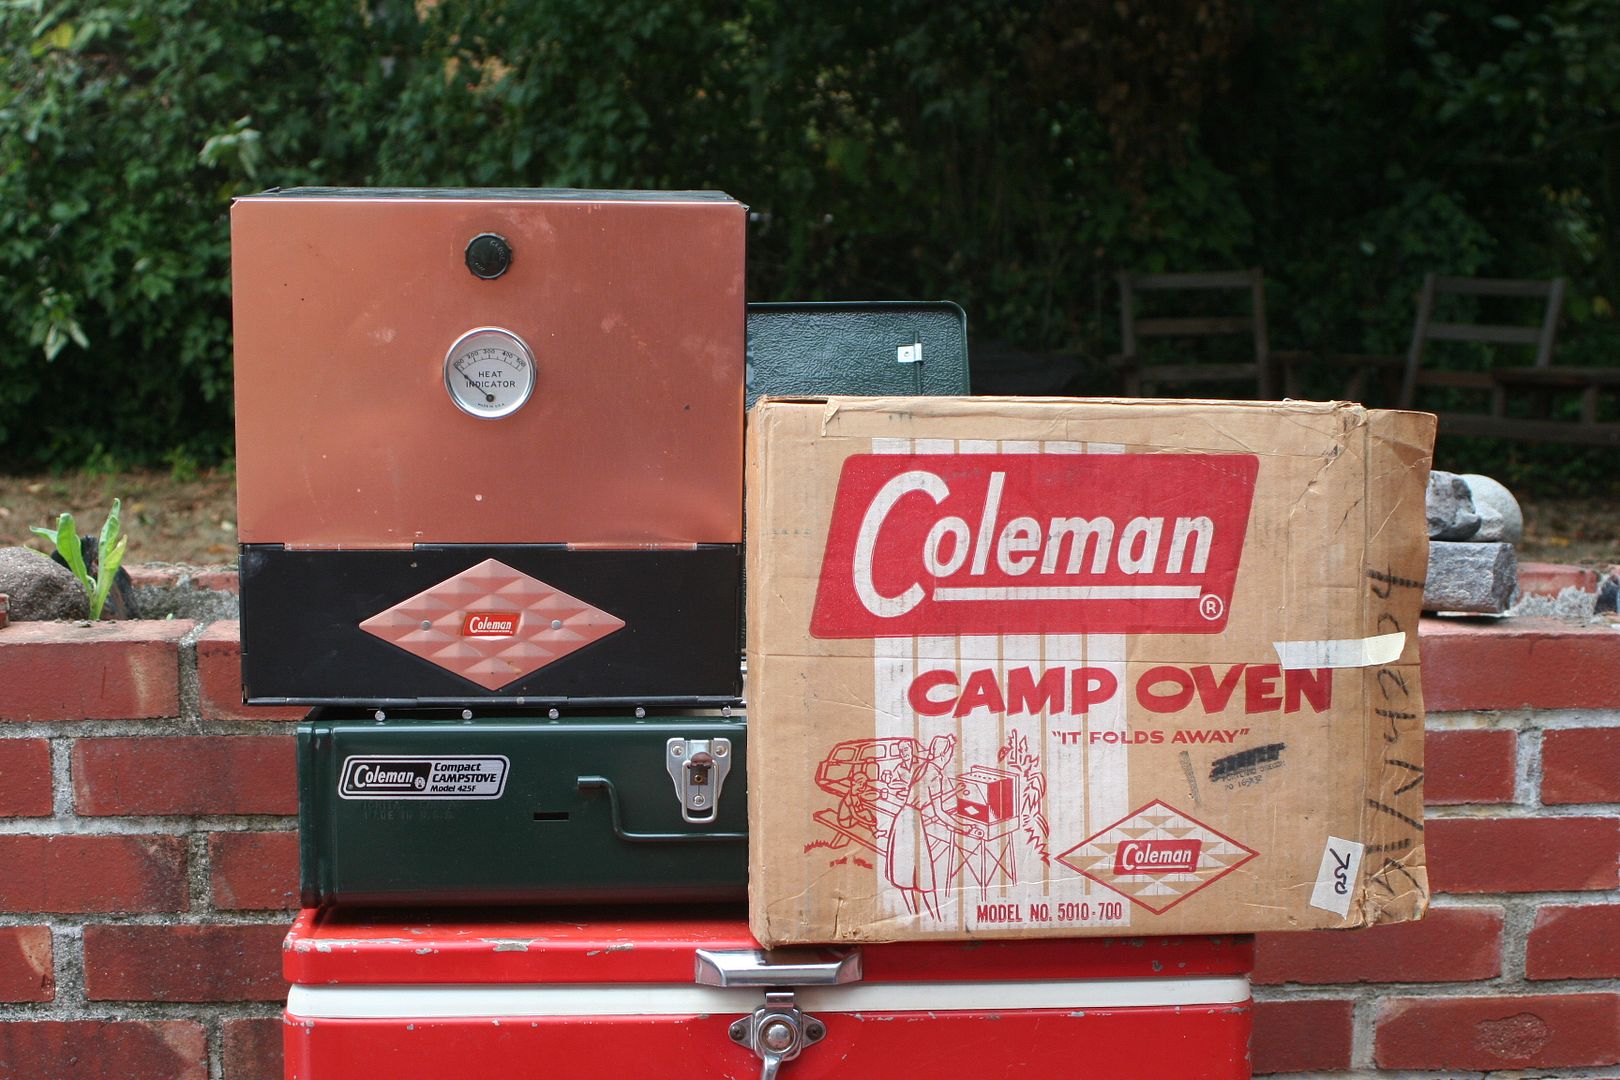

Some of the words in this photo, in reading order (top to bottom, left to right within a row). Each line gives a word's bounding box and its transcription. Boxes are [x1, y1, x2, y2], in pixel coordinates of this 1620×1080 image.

[502, 351, 514, 359] 400
[478, 370, 503, 378] HEAT
[466, 380, 516, 388] INDICATOR
[852, 469, 1215, 618] Coleman
[469, 616, 512, 634] Coleman
[907, 665, 1118, 719] CAMP
[1135, 663, 1333, 715] OVEN
[1089, 730, 1165, 745] FOLDS
[353, 764, 415, 788] Coleman
[434, 762, 482, 773] Compact
[432, 773, 497, 783] CAMPSTOVE
[1122, 843, 1192, 870] Coleman
[976, 904, 1023, 923] MODEL
[1029, 903, 1053, 922] NO.
